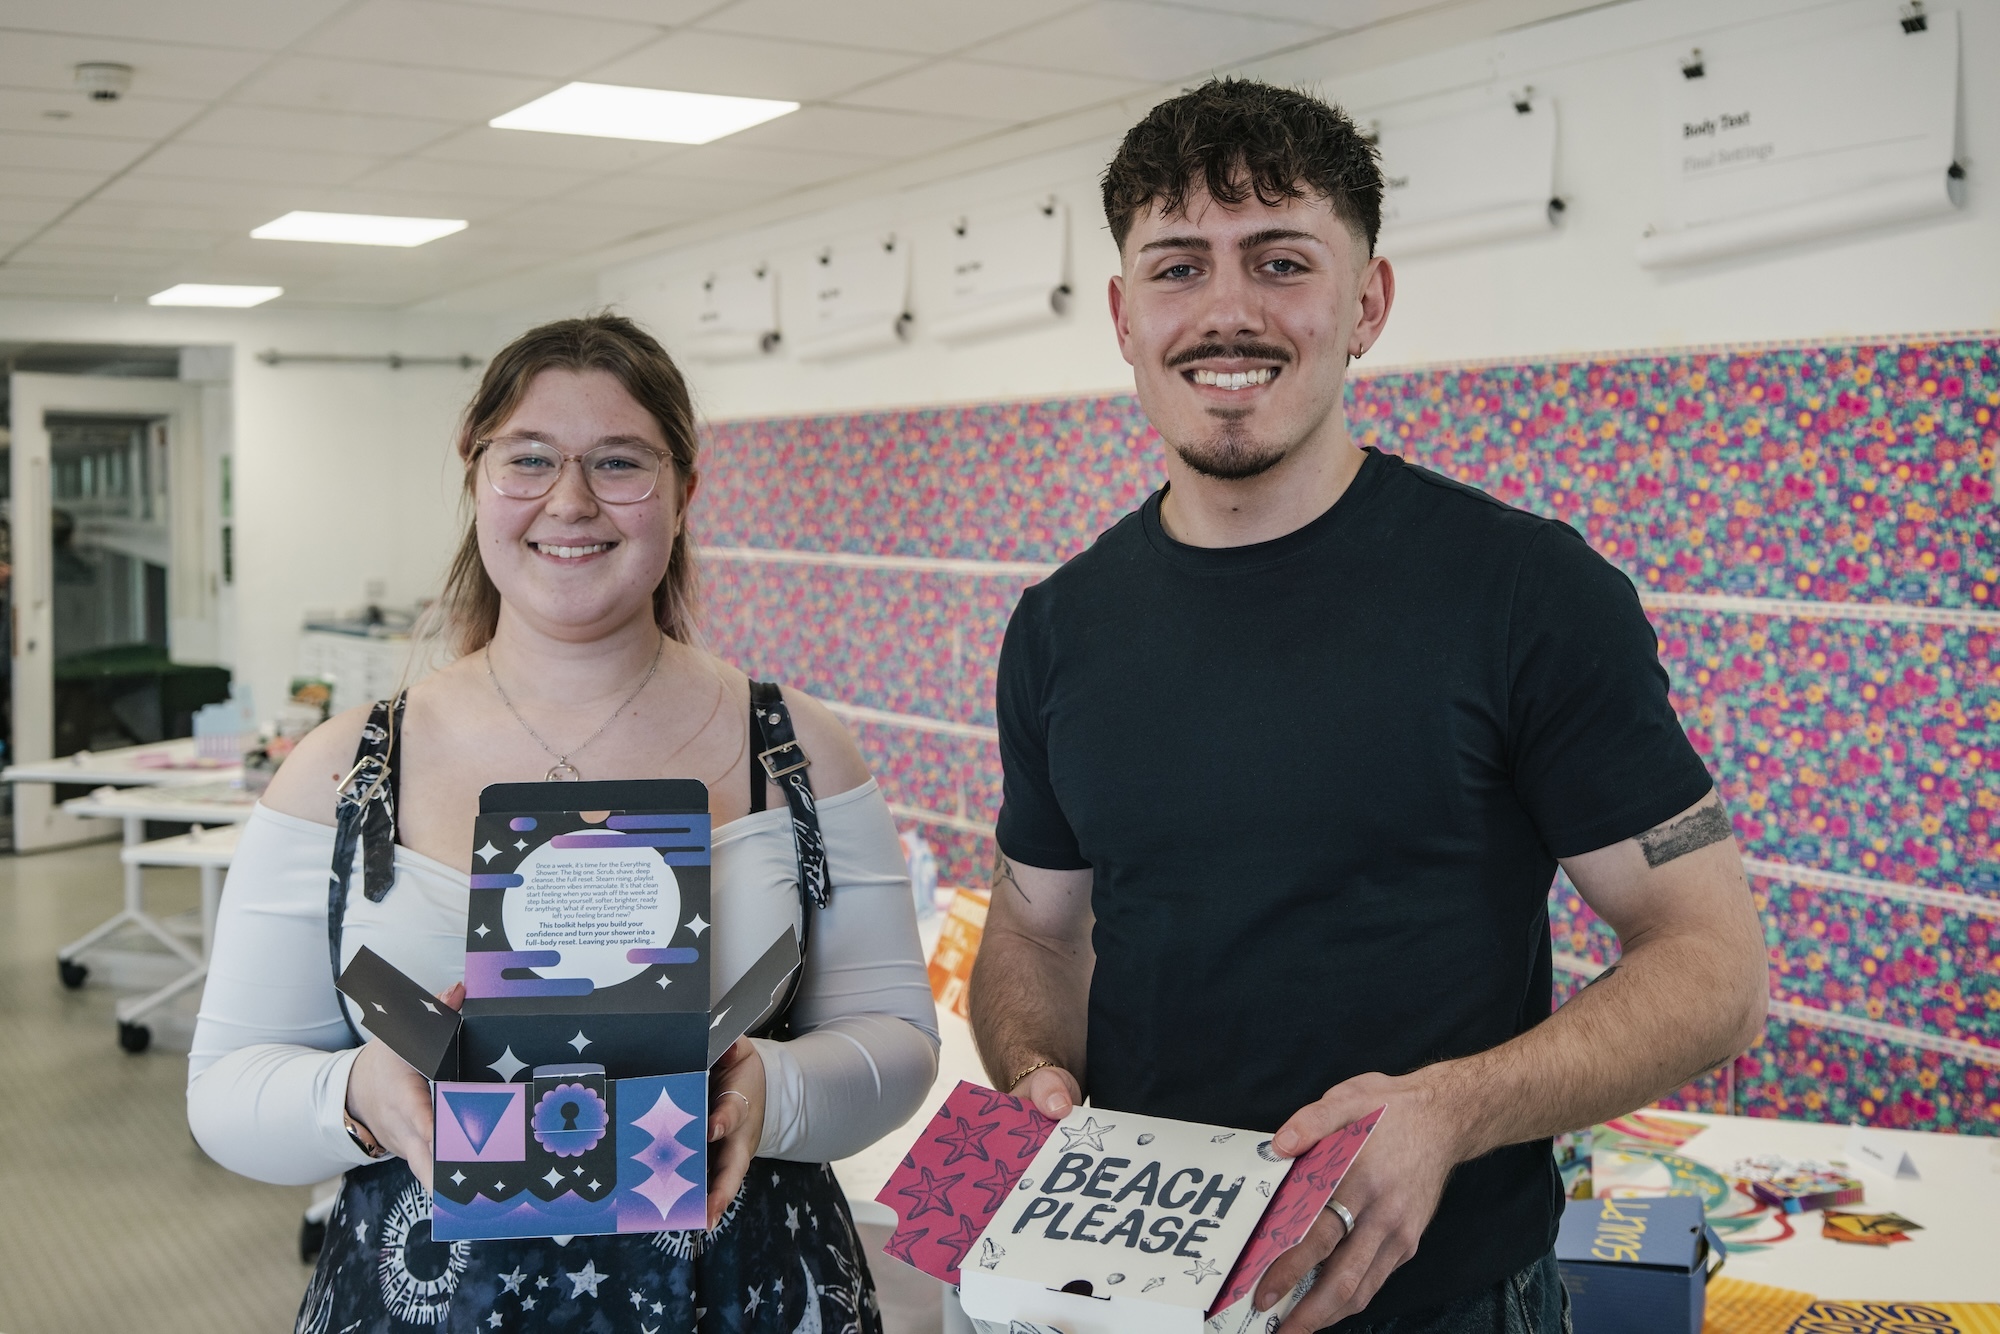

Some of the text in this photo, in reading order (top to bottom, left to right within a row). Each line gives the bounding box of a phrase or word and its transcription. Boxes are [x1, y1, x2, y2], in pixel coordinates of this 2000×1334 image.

[1683, 112, 1750, 138] Body Text
[620, 861, 651, 869] Everything
[640, 896, 657, 904] ready
[604, 904, 635, 912] Everything
[576, 912, 596, 920] feeling
[577, 921, 596, 929] helps
[579, 938, 605, 947] Leaving
[1040, 1152, 1246, 1219] BEACH
[1011, 1197, 1220, 1258] PLEASE
